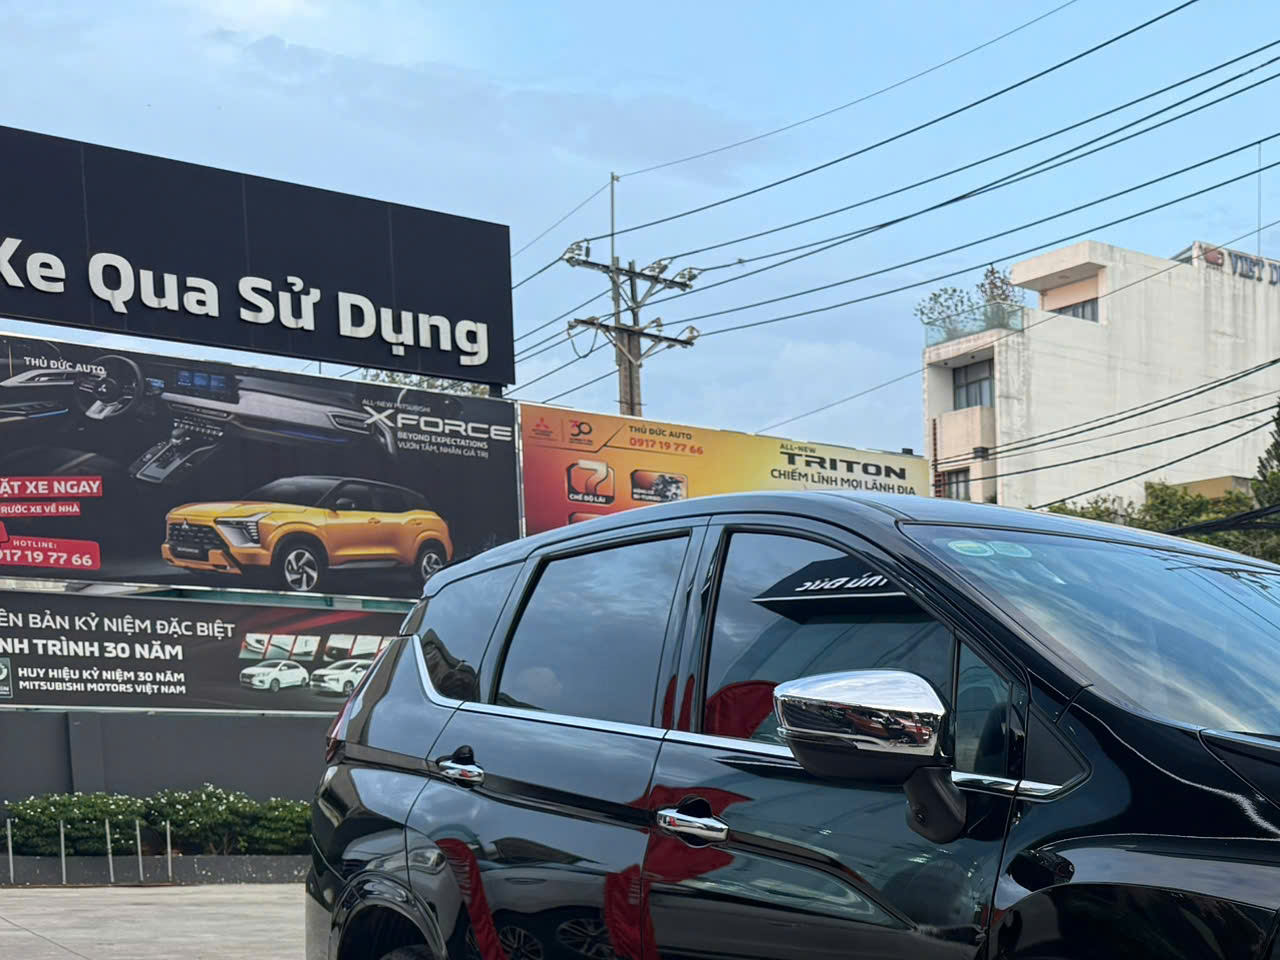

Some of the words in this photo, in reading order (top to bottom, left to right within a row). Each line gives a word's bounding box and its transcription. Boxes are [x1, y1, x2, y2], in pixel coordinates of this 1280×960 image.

[88, 252, 219, 317] Qua
[238, 275, 321, 331] Sử
[338, 291, 489, 366] Dụng
[24, 355, 47, 368] THỦ
[49, 357, 73, 371] ĐỨC
[74, 363, 106, 376] AUTO
[363, 405, 513, 441] XFORCE
[397, 431, 430, 443] BEYOND
[431, 436, 488, 449] EXPECTATIONS
[629, 425, 647, 435] THỦ
[649, 425, 667, 437] ĐỨC
[669, 431, 692, 440] AUTO
[629, 438, 657, 449] 0917
[659, 441, 671, 450] 19
[780, 443, 816, 453] ALL-NEW
[780, 451, 907, 480] TRITON
[770, 467, 808, 482] CHIẾM
[811, 472, 838, 486] LĨNH
[25, 481, 48, 494] XE
[53, 480, 100, 494] NGAY
[30, 505, 42, 513] XE
[13, 540, 57, 549] HOTLINE:
[24, 551, 44, 563] 19
[47, 552, 67, 564] 77
[71, 554, 93, 566] 66
[28, 609, 70, 630] BẢN
[74, 612, 100, 631] KỶ
[103, 614, 152, 636] NIỆM
[156, 617, 193, 638] ĐẶC
[196, 619, 236, 640] BIỆT
[32, 635, 100, 657] TRÌNH
[103, 642, 131, 658] 30
[134, 640, 183, 660] NĂM
[18, 667, 46, 678] HUY
[48, 666, 79, 681] HIỆU
[82, 666, 100, 680] KỶ
[102, 668, 135, 682] NIỆM
[137, 671, 153, 682] 30
[155, 670, 185, 682] NĂM
[19, 680, 85, 691] MITSUBISHI
[87, 683, 133, 693] MOTORS
[135, 682, 159, 695] VIỆT
[160, 685, 186, 694] NAM
